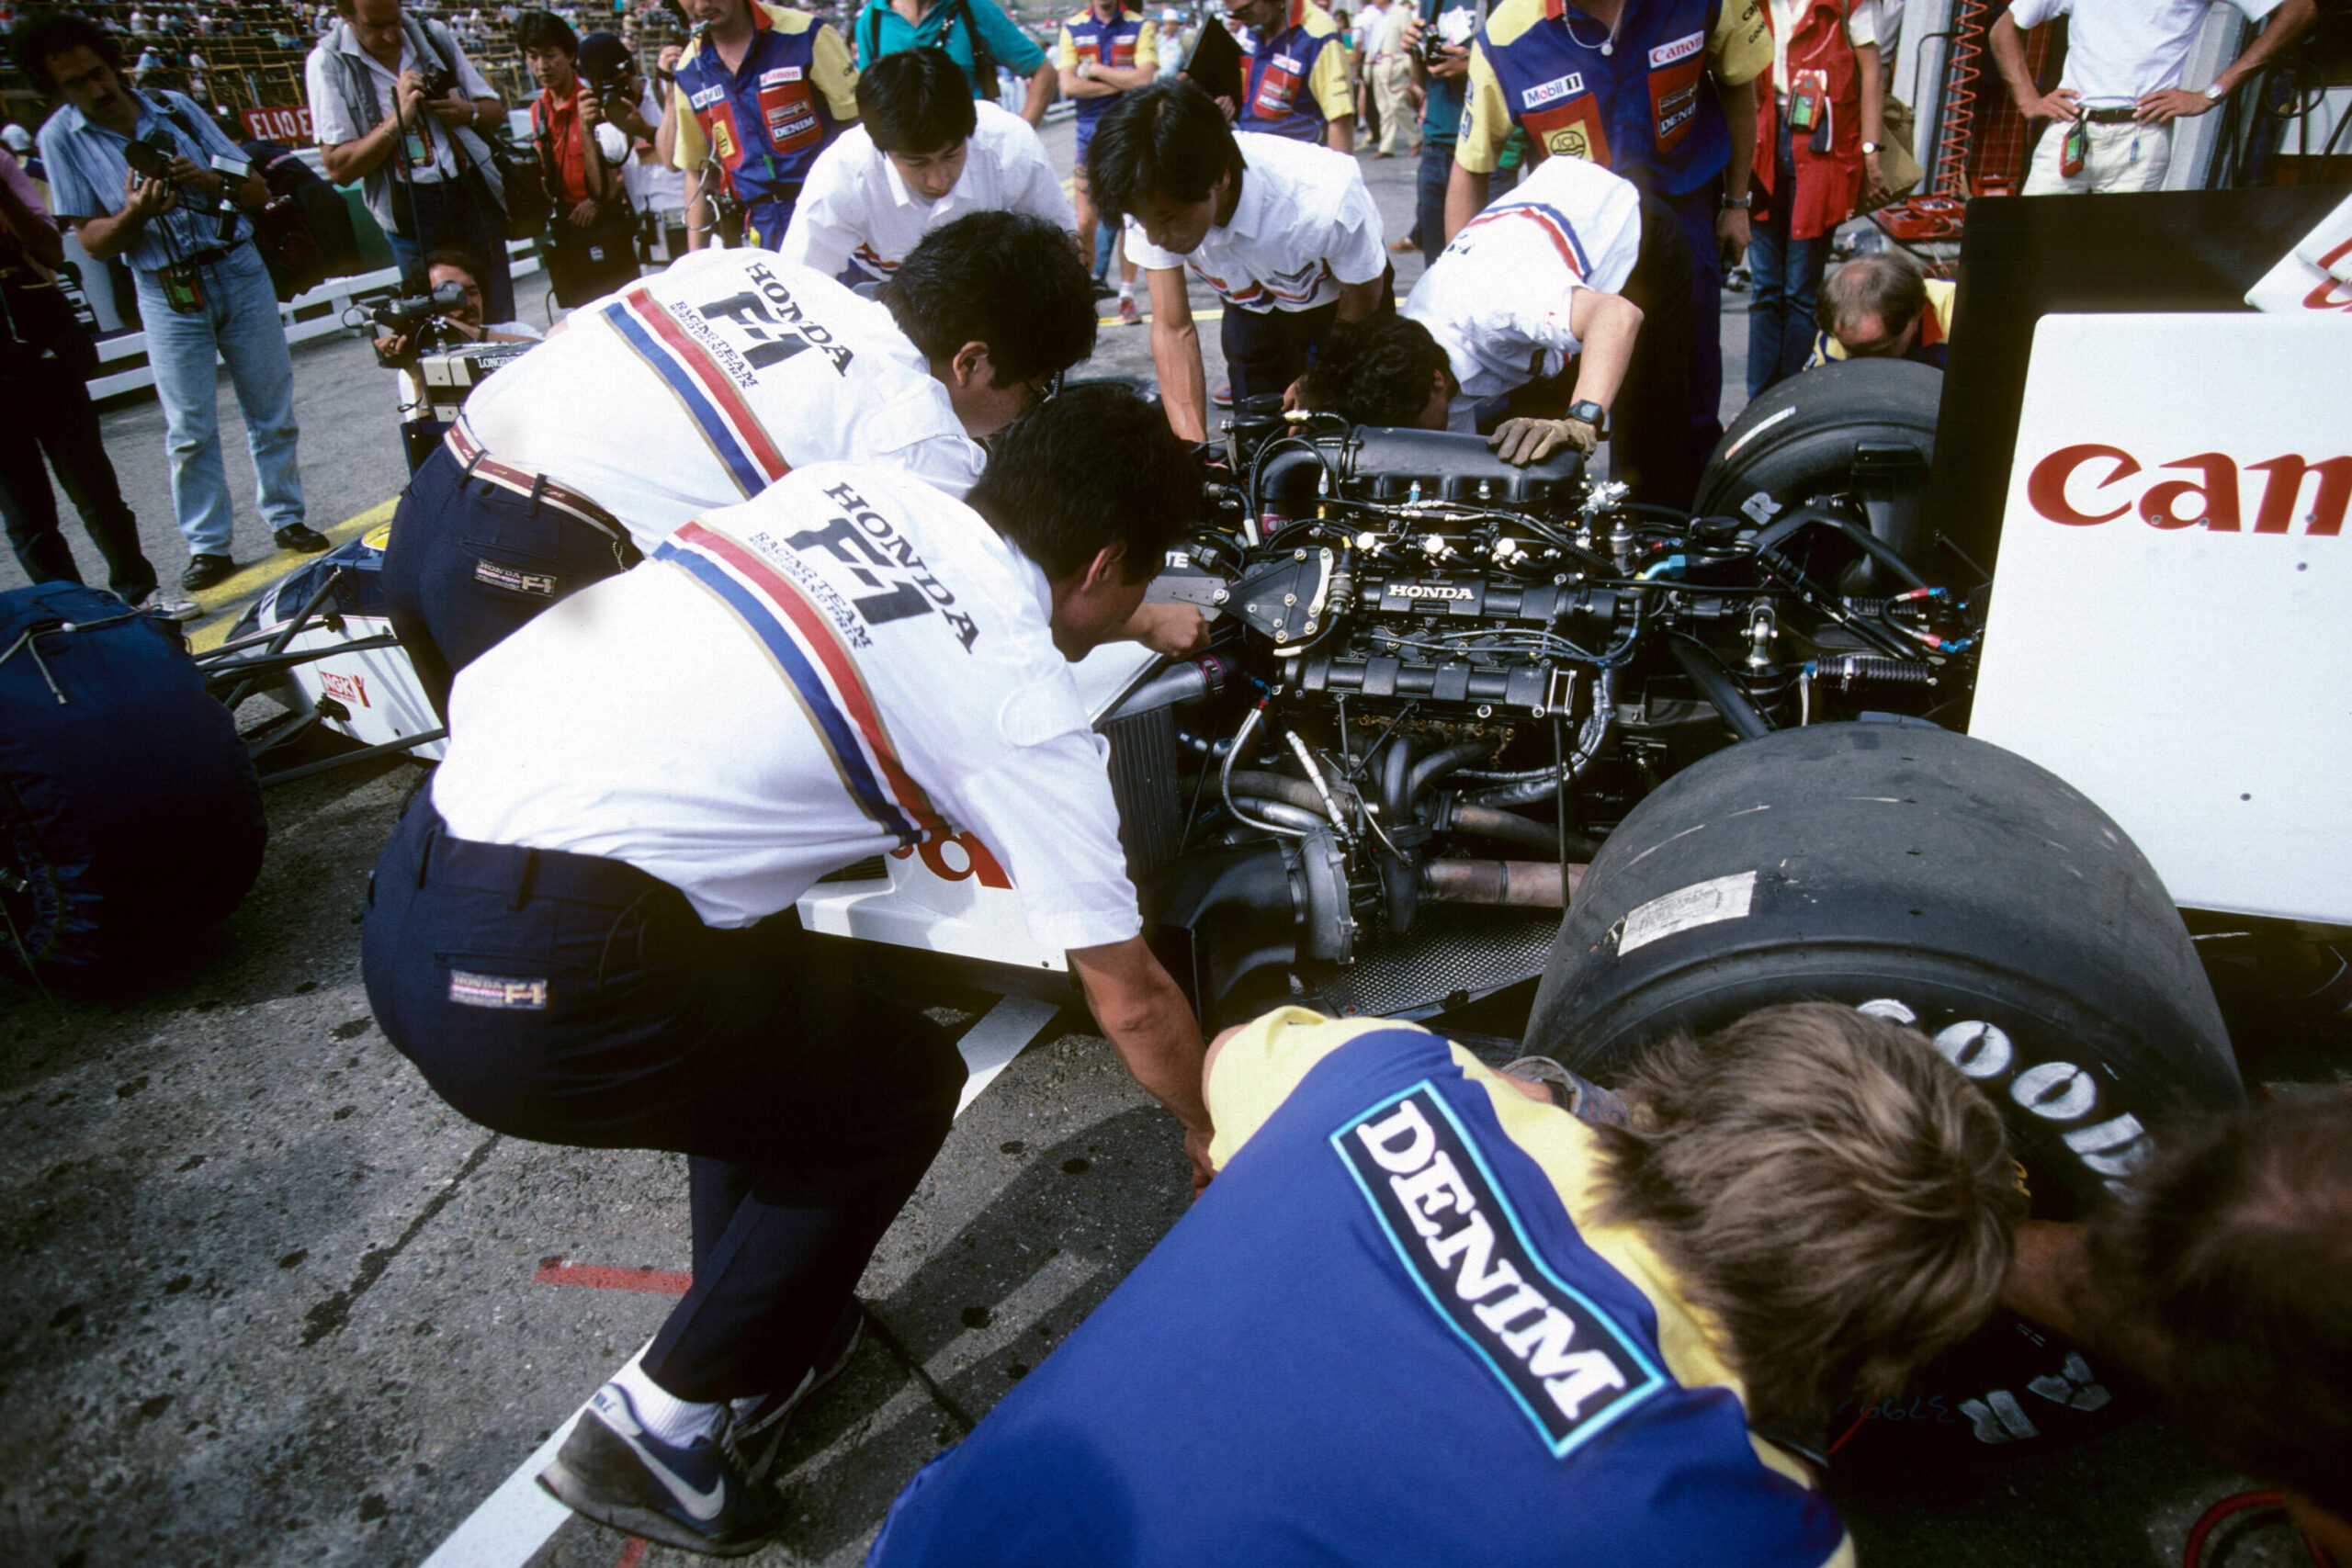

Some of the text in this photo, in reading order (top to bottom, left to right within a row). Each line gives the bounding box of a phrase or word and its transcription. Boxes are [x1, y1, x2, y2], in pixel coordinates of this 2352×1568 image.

[1652, 36, 1702, 63] Canon
[1527, 81, 1565, 105] Mobil
[249, 110, 298, 141] ELIO
[774, 116, 816, 140] DENIM
[1556, 134, 1577, 149] ICI
[744, 262, 854, 378] HONDA
[717, 340, 760, 387] TEAM
[722, 356, 752, 389] PRIX
[822, 481, 980, 655] HONDA
[755, 530, 875, 649] RACING TEAM
[1388, 584, 1475, 600] HONDA
[1355, 1100, 1627, 1421] DENIM
